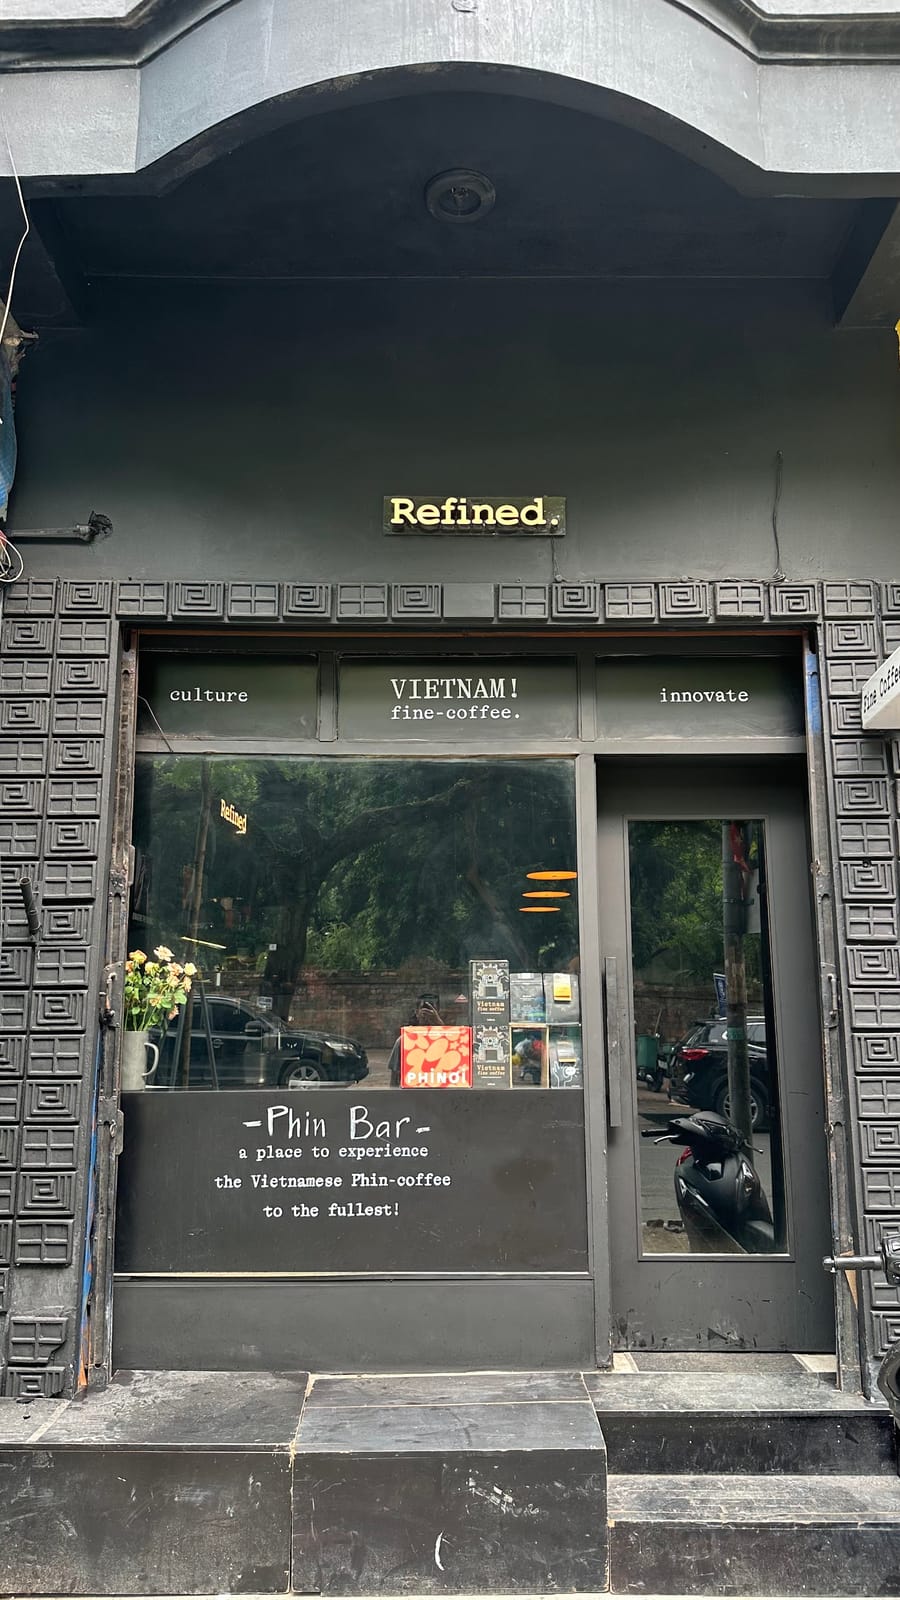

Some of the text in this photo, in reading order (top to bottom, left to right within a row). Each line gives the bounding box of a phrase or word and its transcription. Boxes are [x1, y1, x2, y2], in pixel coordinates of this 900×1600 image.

[390, 497, 559, 526] Refined.
[169, 687, 249, 702] culture
[390, 678, 518, 699] VIETNAM!
[659, 688, 749, 703] innovate
[863, 665, 900, 714] Fine Coffe
[390, 705, 521, 720] fine-coffee.
[238, 1143, 429, 1162] a place to experience
[214, 1172, 451, 1189] the Vietnamese Phin-coffee
[263, 1202, 400, 1218] to the fullest!
